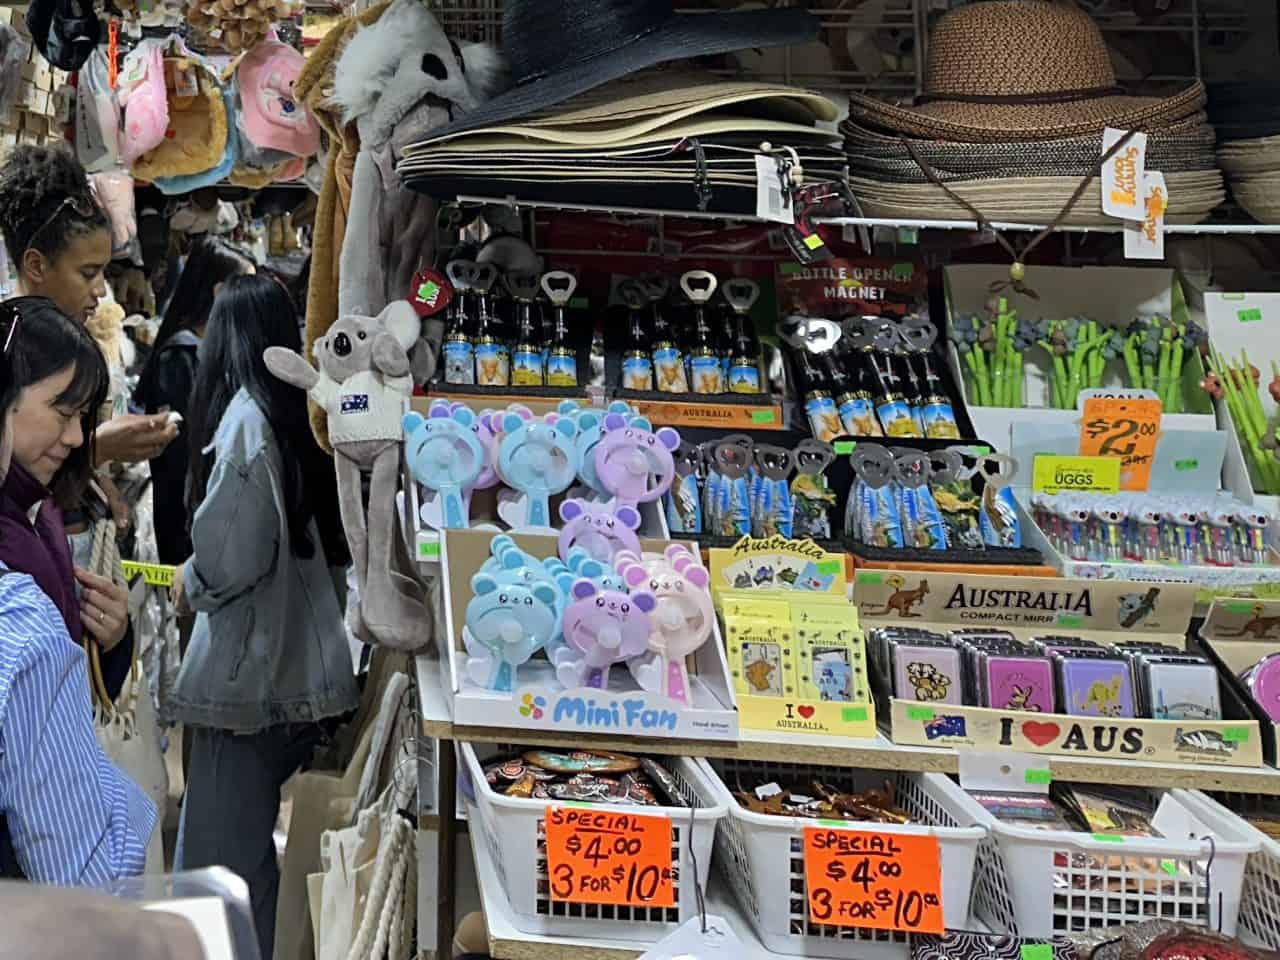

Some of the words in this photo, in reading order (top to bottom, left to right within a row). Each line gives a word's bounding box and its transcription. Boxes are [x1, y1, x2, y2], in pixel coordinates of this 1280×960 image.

[823, 285, 887, 300] MAGNET
[682, 408, 733, 418] AUSTRALIA
[1054, 473, 1094, 486] UGGS
[734, 536, 825, 560] Australia
[944, 583, 1095, 617] AUSTRALIA
[959, 610, 1021, 622] COMPACT
[1023, 614, 1054, 624] MIRR
[553, 696, 620, 729] Mini
[622, 698, 678, 730] Fan
[785, 703, 794, 719] I
[776, 720, 825, 731] AUSTRALIA
[999, 717, 1014, 746] I
[1061, 723, 1144, 754] AUS
[551, 809, 645, 833] SPECIAL
[565, 833, 642, 868] $4.00
[811, 830, 902, 853] SPECIAL
[551, 863, 574, 899] 3
[580, 874, 612, 893] FOR
[825, 856, 902, 894] $4.00
[811, 887, 832, 920] 3
[838, 900, 877, 920] FOR
